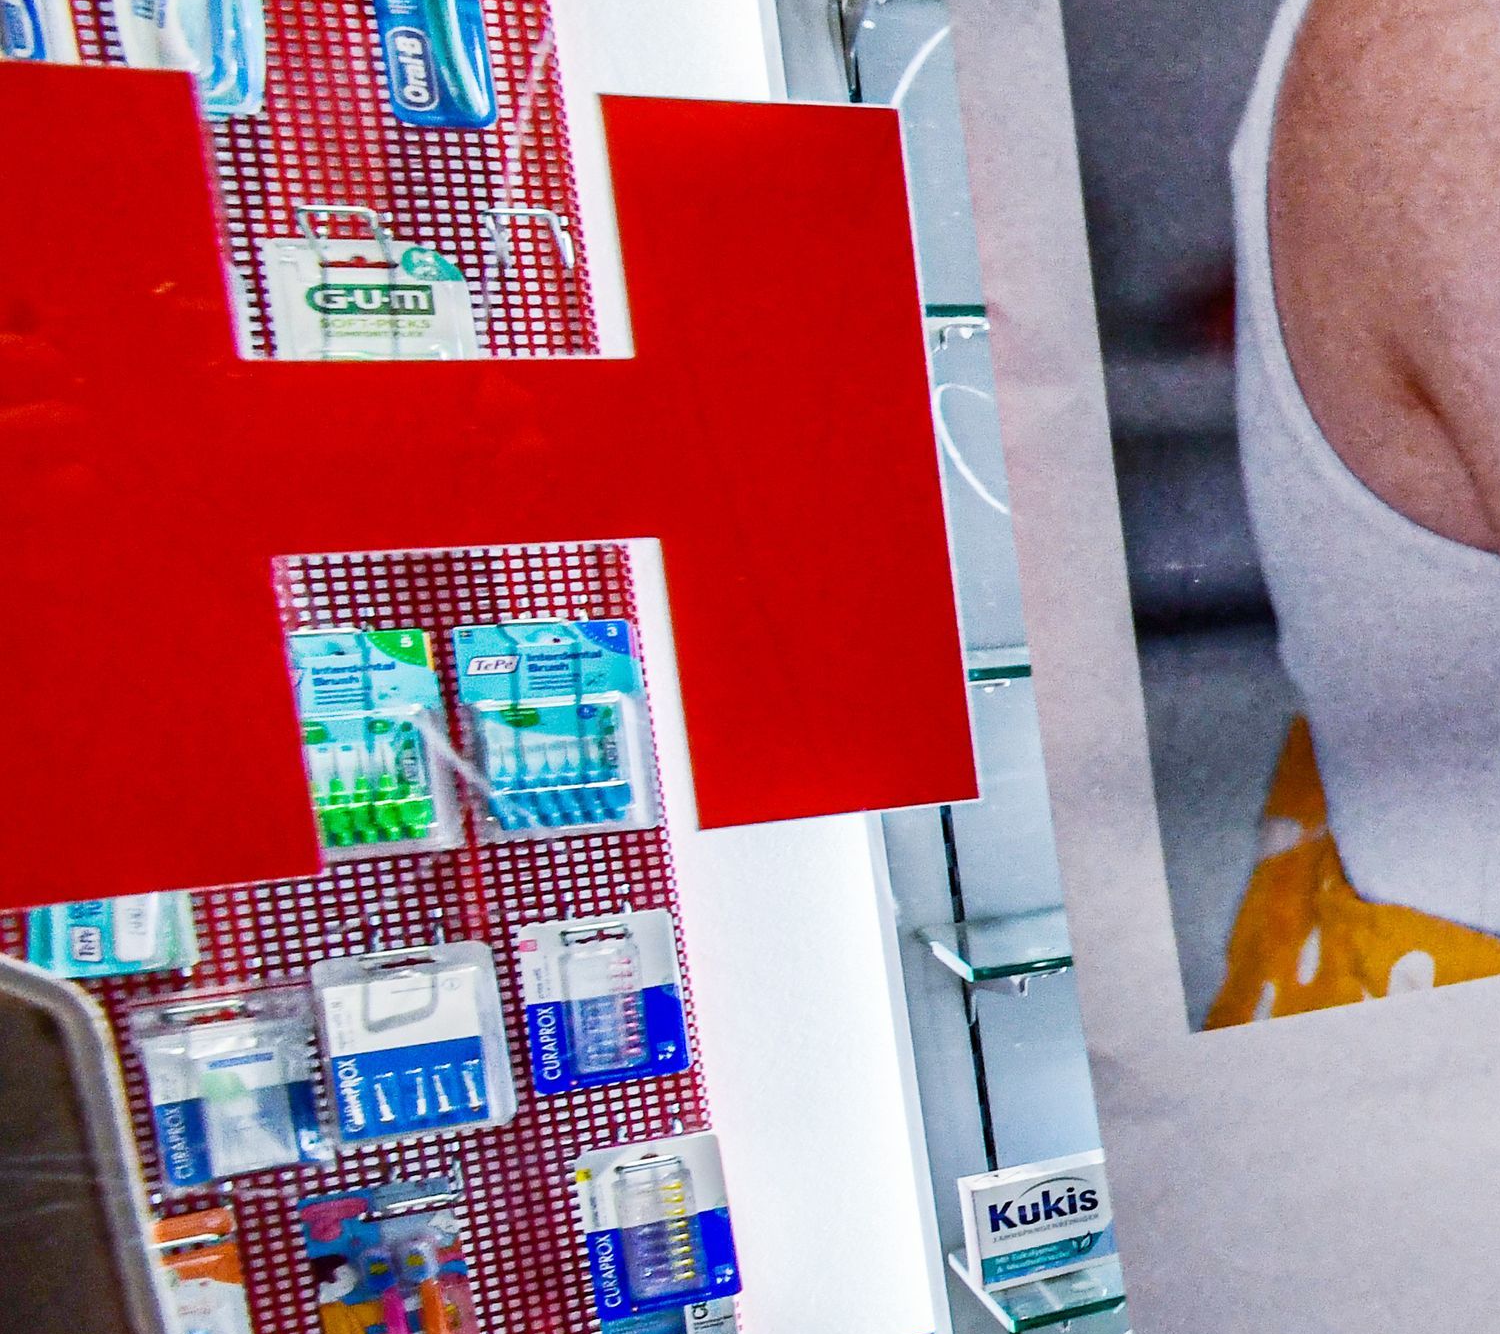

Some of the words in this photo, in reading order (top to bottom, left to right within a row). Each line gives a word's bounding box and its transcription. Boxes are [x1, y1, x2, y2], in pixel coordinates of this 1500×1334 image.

[395, 35, 430, 104] Oral-B
[607, 626, 619, 638] 3
[526, 650, 601, 662] Interdental
[311, 661, 396, 675] Interdental
[474, 657, 518, 672] TePe
[527, 662, 571, 673] Brush
[312, 674, 360, 686] Brush
[541, 1005, 563, 1081] CURAPROX
[165, 1104, 195, 1181] CURAPROX
[987, 1186, 1100, 1234] Kukis
[594, 1233, 622, 1309] CURAPROX
